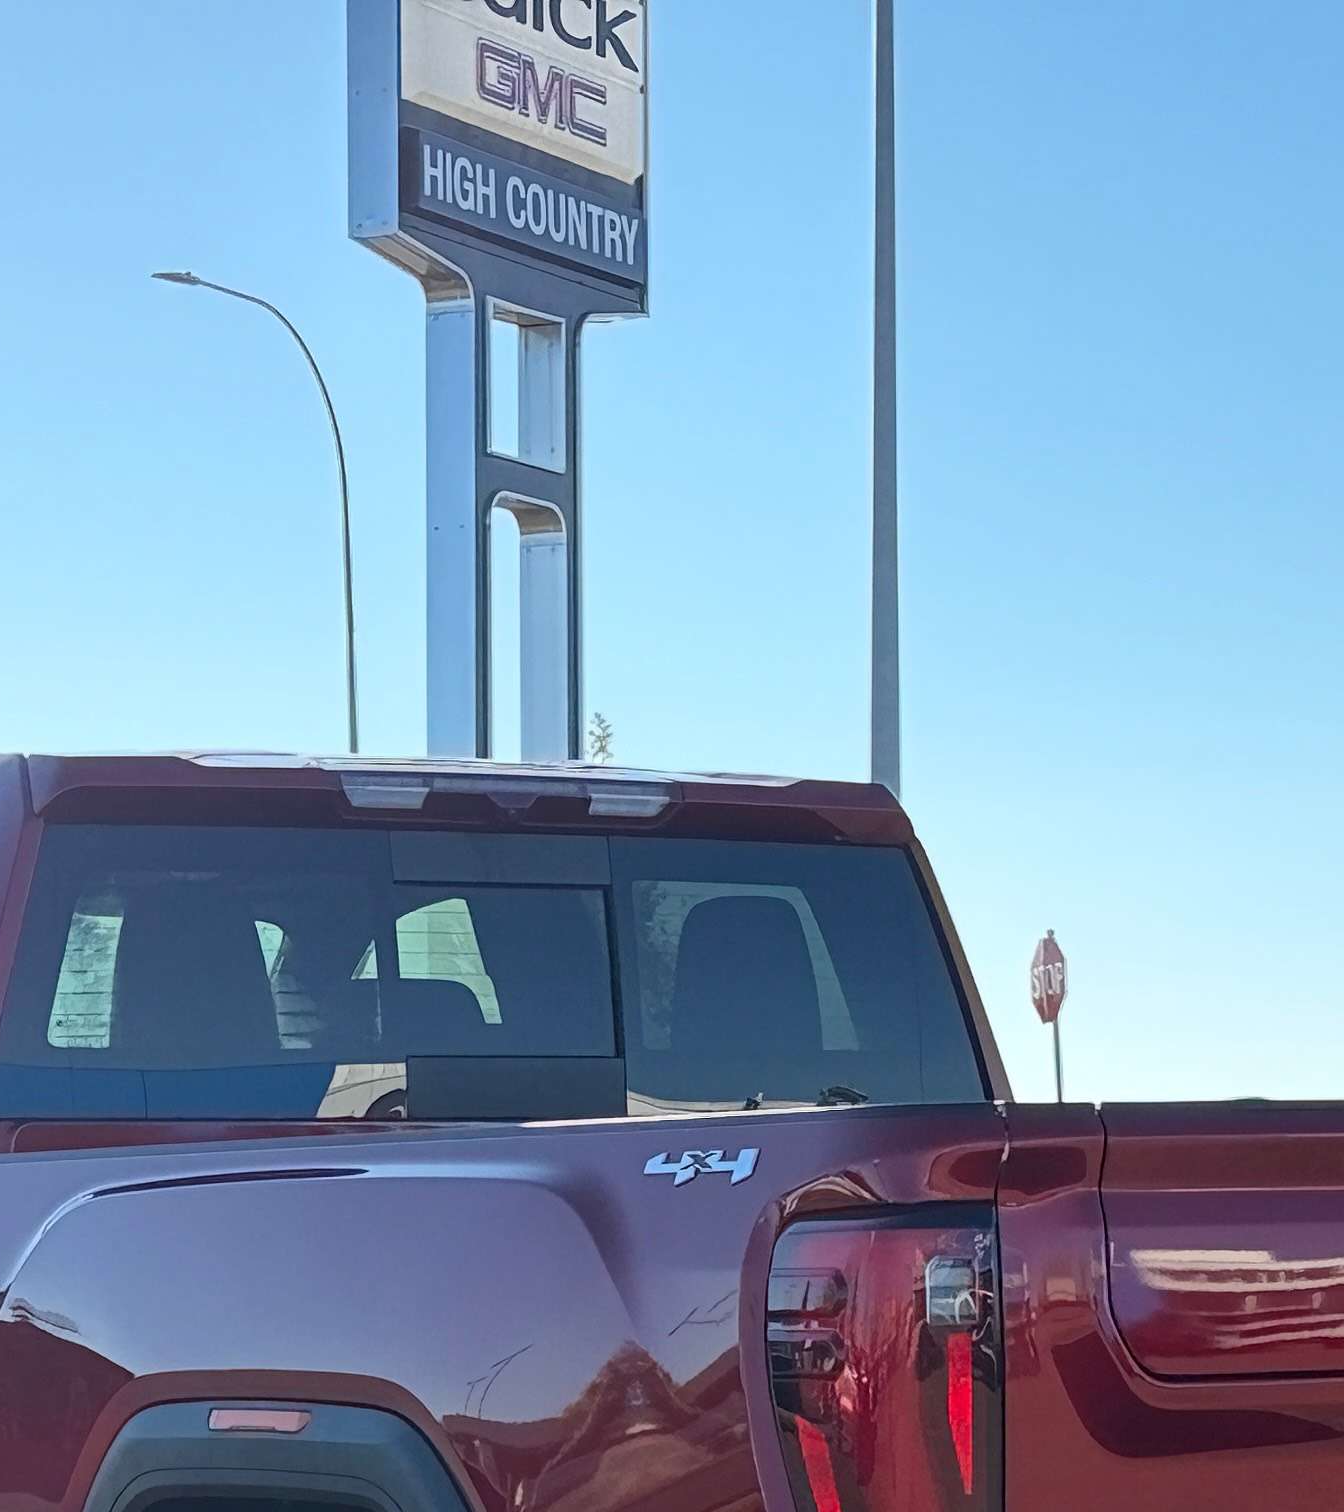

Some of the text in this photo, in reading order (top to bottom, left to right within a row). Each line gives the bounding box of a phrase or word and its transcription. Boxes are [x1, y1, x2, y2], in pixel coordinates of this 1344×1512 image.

[476, 37, 607, 146] GMC
[423, 144, 638, 265] HIGH COUNTRY
[1032, 963, 1063, 999] STOP
